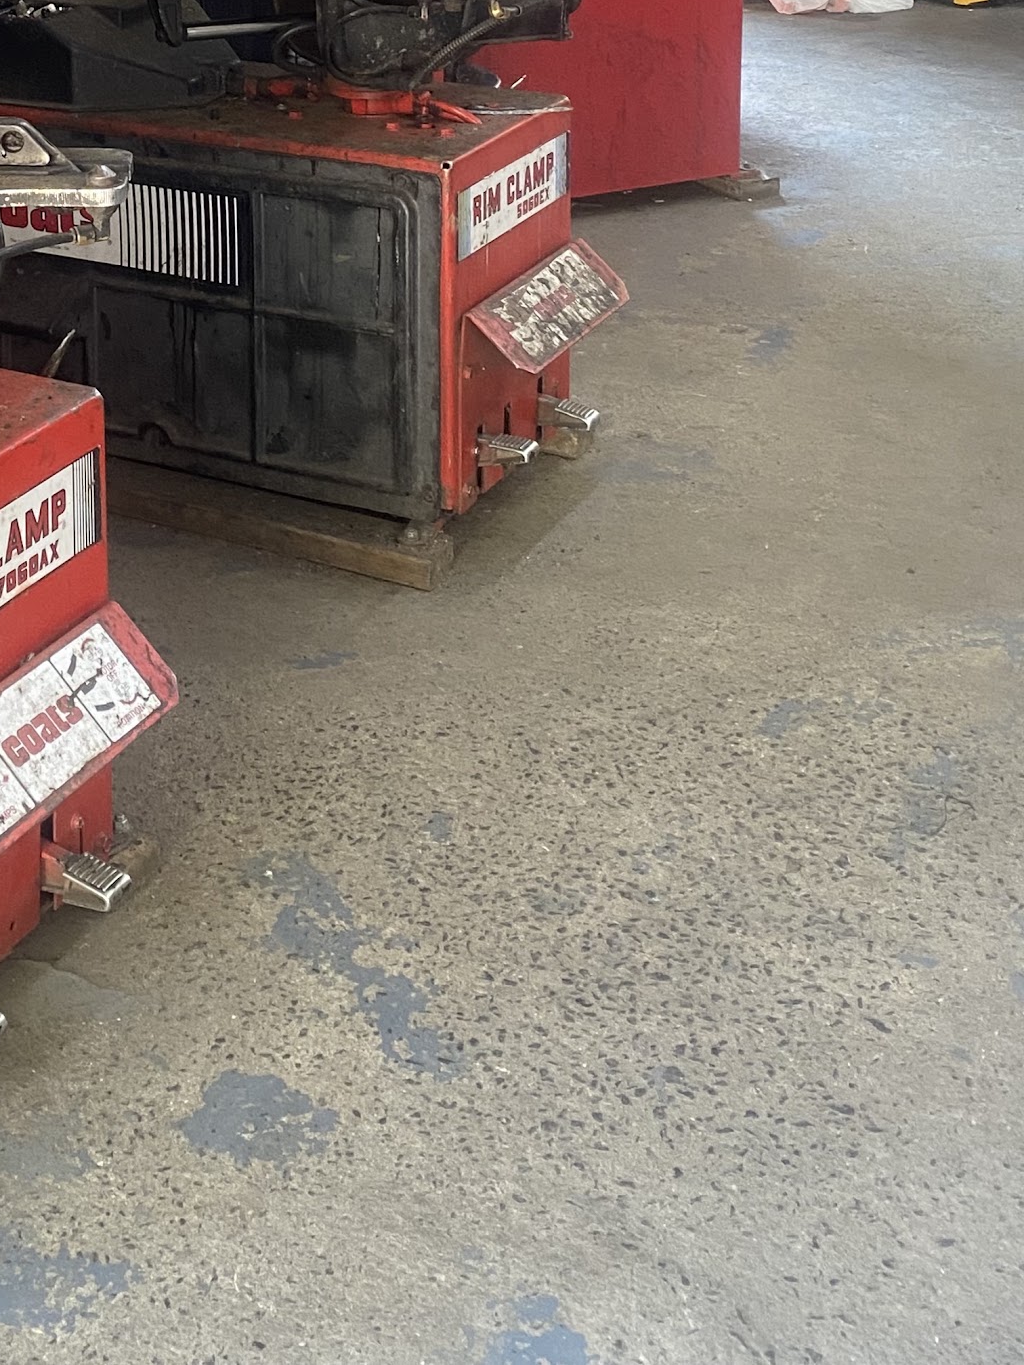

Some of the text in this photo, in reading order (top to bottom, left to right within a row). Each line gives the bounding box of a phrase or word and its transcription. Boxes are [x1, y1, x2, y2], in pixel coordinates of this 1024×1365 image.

[472, 152, 554, 227] RIM CLAMP
[516, 185, 550, 219] 5060EX
